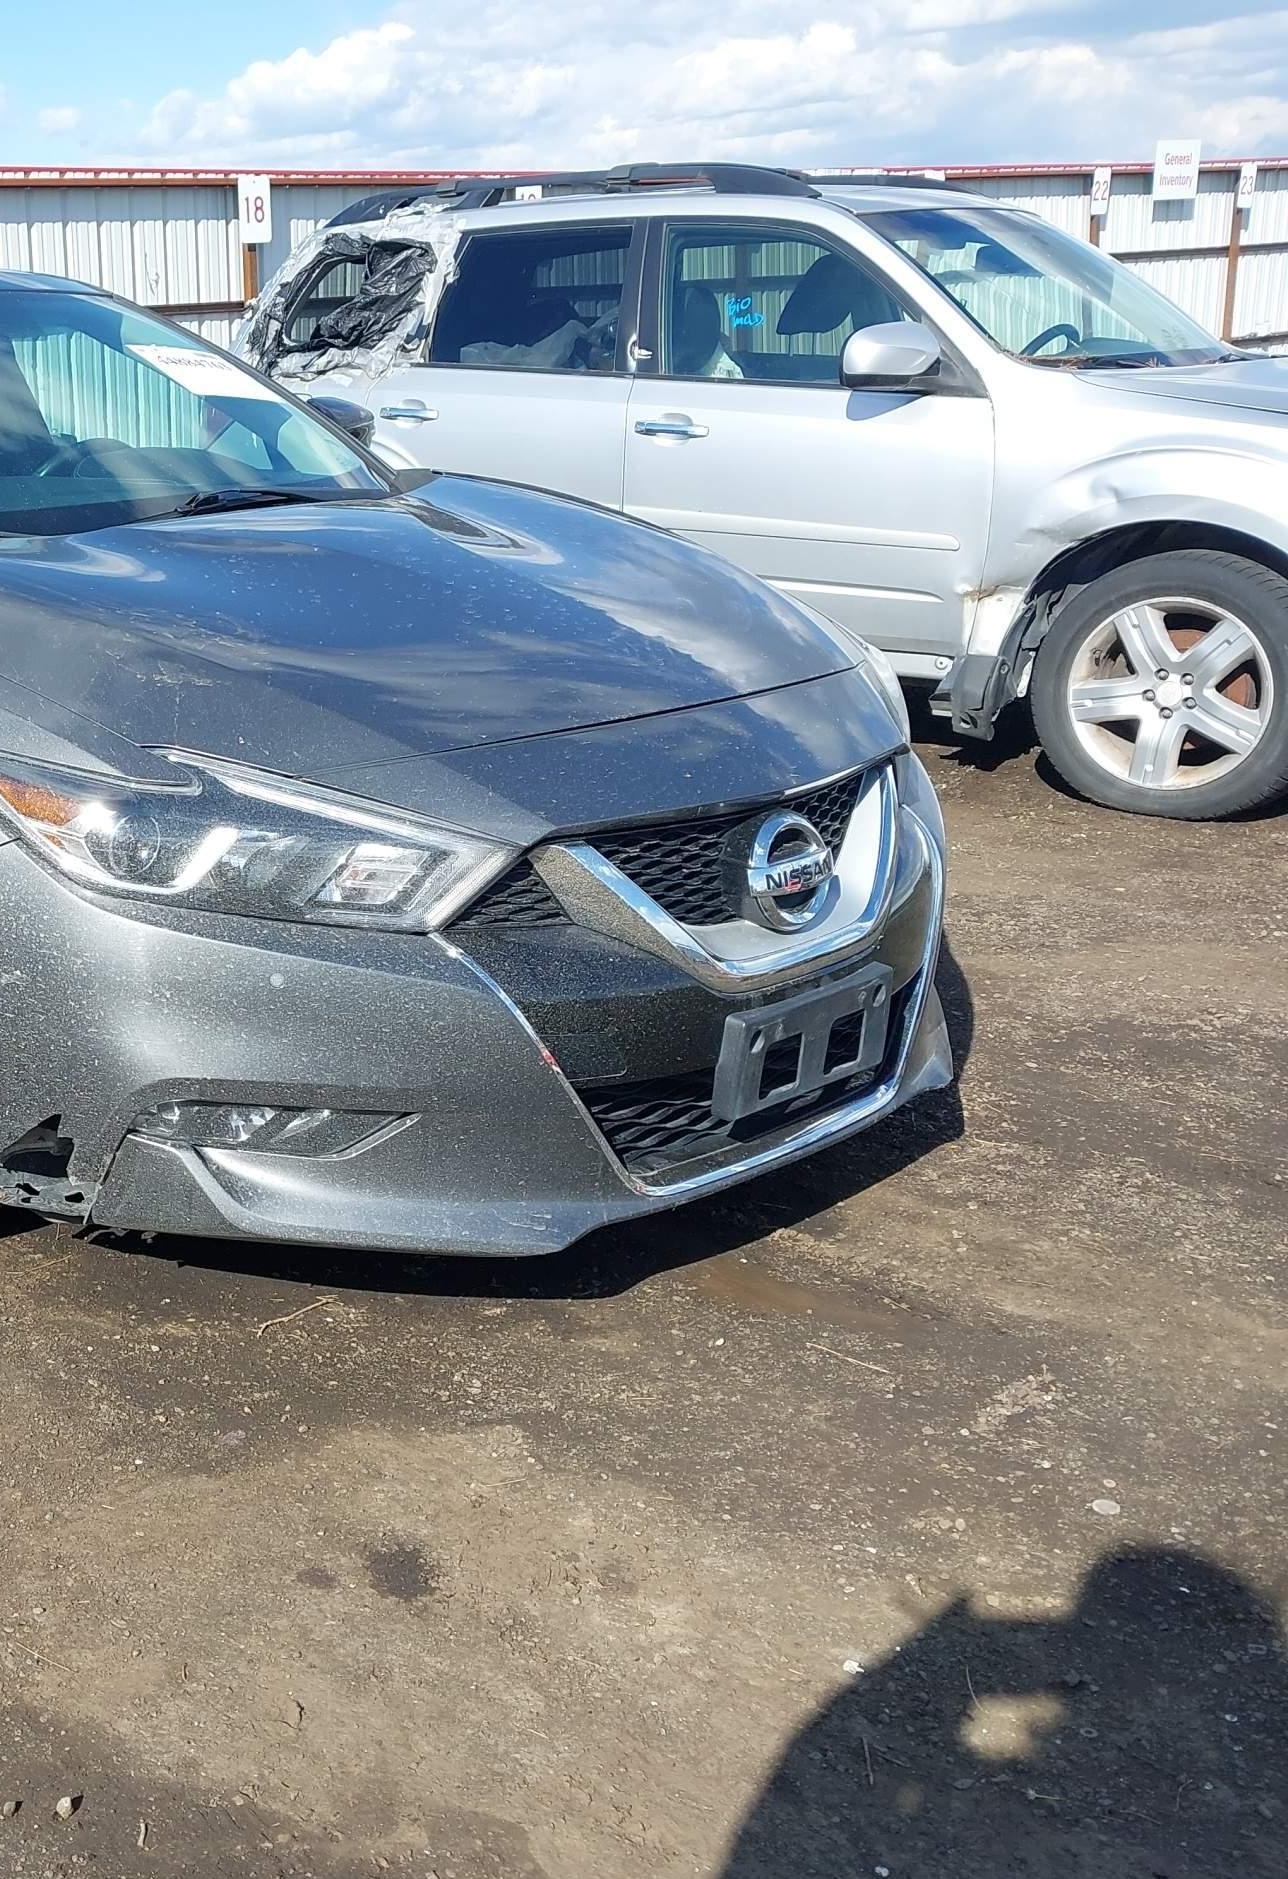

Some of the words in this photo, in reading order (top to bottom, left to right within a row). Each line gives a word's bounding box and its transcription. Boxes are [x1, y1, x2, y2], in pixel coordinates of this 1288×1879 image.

[1163, 152, 1193, 166] General
[1093, 180, 1109, 201] 22
[1159, 174, 1194, 188] Inventory
[1240, 175, 1254, 195] 23
[244, 196, 265, 223] 18
[765, 857, 833, 890] NISSAN
